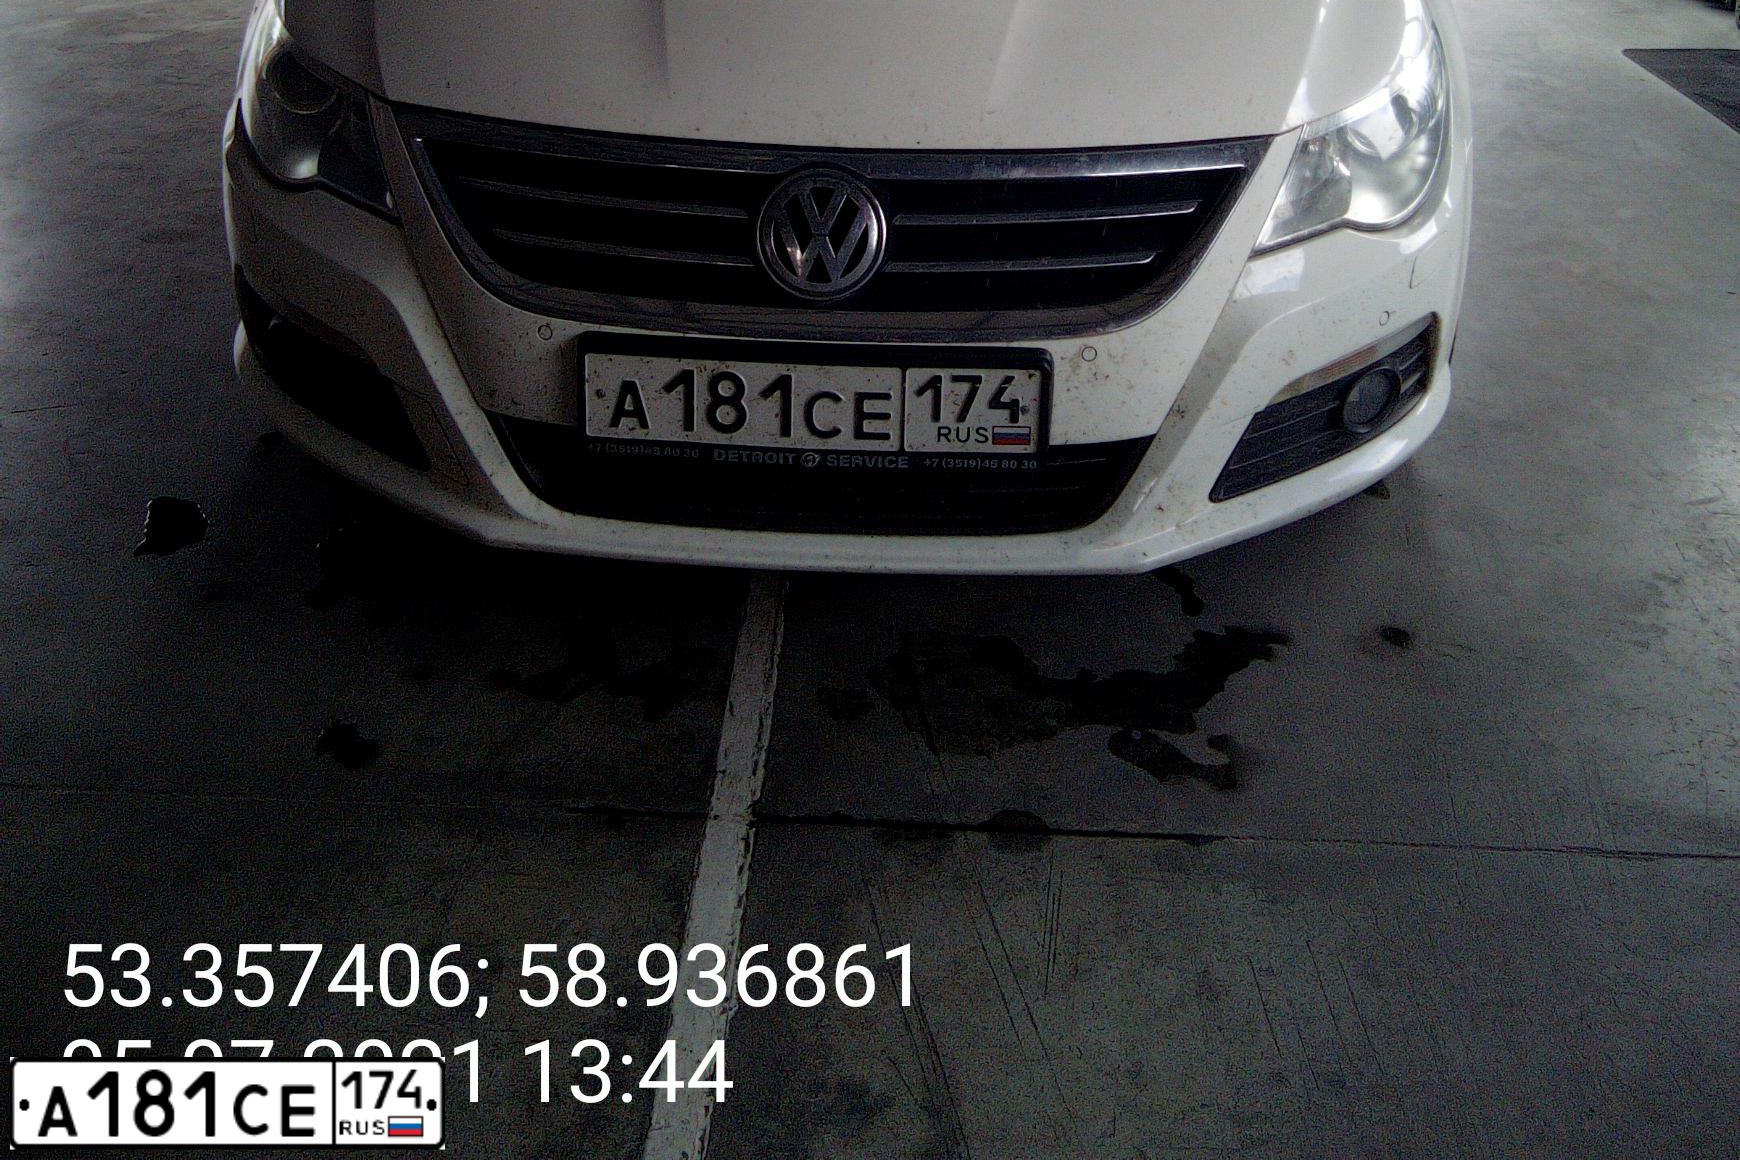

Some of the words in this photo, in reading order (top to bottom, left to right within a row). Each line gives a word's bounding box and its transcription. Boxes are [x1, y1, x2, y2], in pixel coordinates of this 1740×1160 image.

[913, 373, 1020, 424] 174
[936, 425, 989, 444] RUS
[712, 448, 797, 465] DETROIT
[826, 454, 910, 469] SERVICE
[1020, 459, 1038, 470] 30
